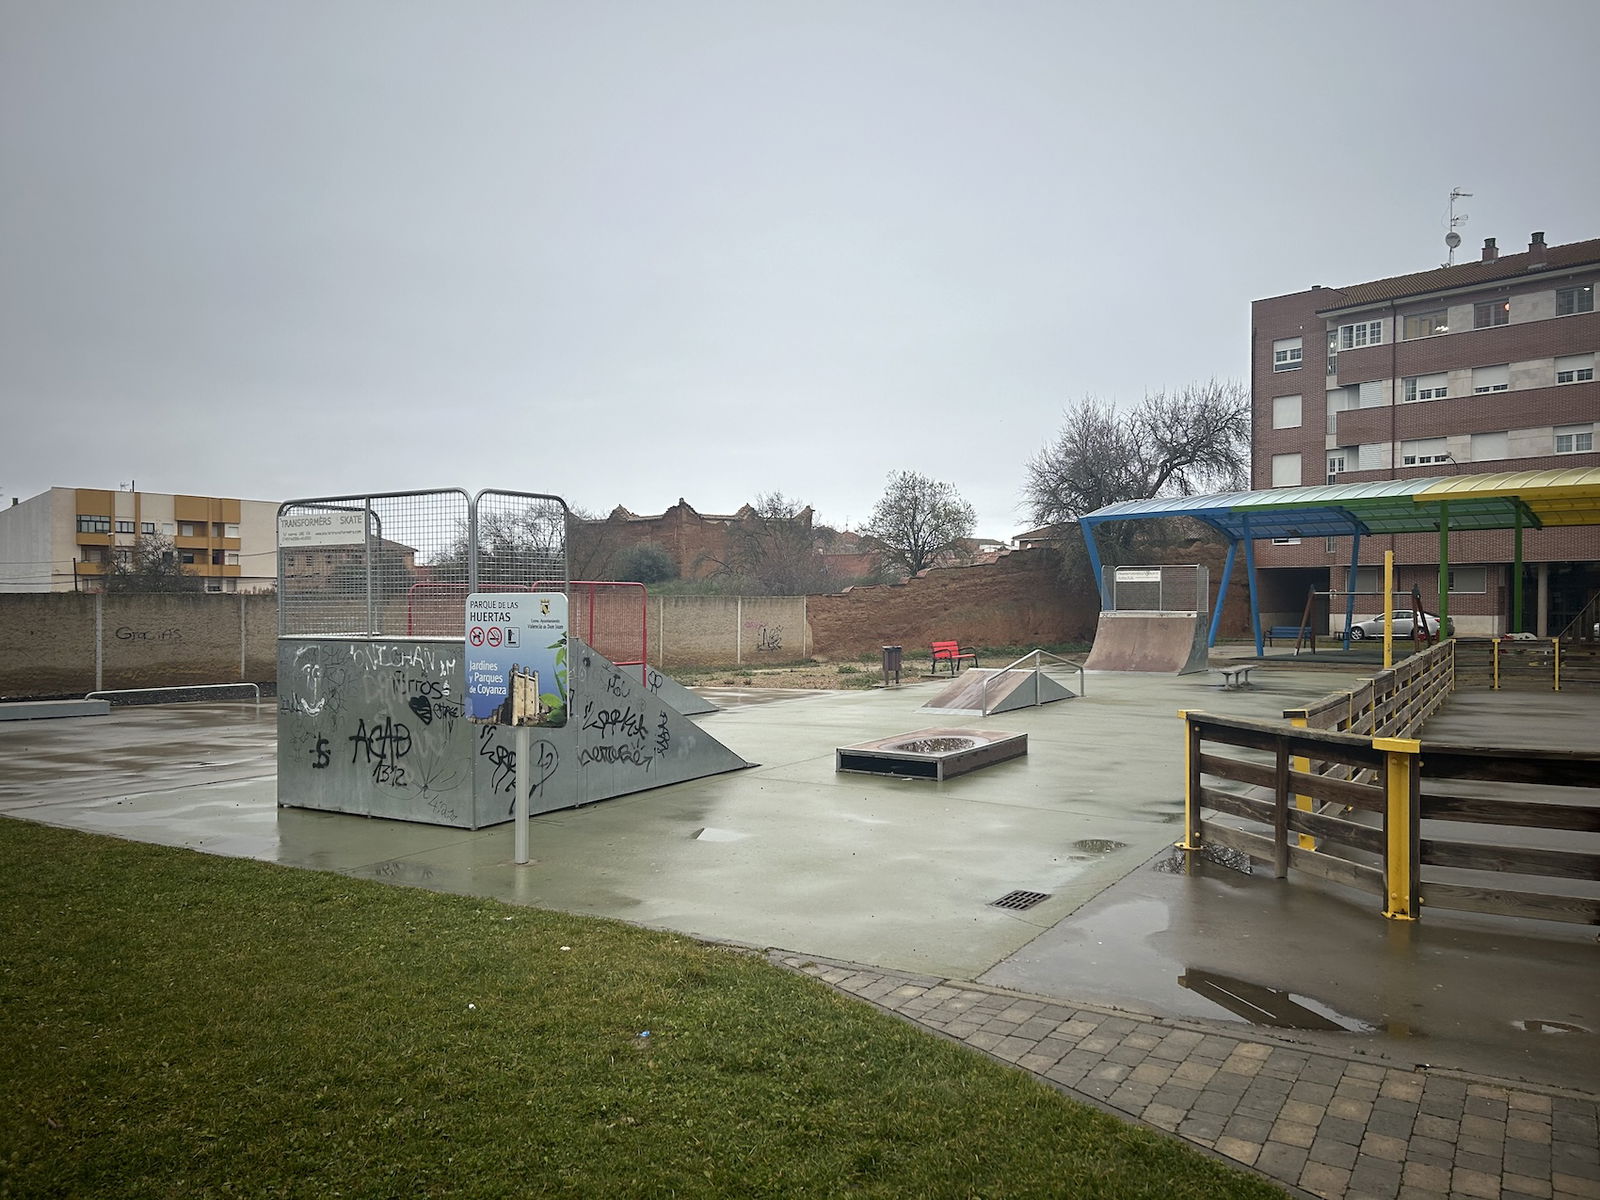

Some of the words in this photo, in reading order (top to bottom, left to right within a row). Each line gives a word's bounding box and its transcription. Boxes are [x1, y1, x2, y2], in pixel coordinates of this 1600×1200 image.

[281, 516, 331, 528] TRANSFORMERS
[340, 515, 363, 525] SKATE
[470, 600, 496, 610] PARQUE
[498, 601, 506, 609] DE
[507, 601, 519, 609] LAS
[470, 611, 511, 622] HUERTAS
[469, 660, 498, 671] Jardines
[469, 675, 474, 683] y
[474, 671, 503, 685] Parques
[469, 685, 476, 694] de
[477, 683, 507, 697] Coyanza
[349, 716, 412, 768] ACAB
